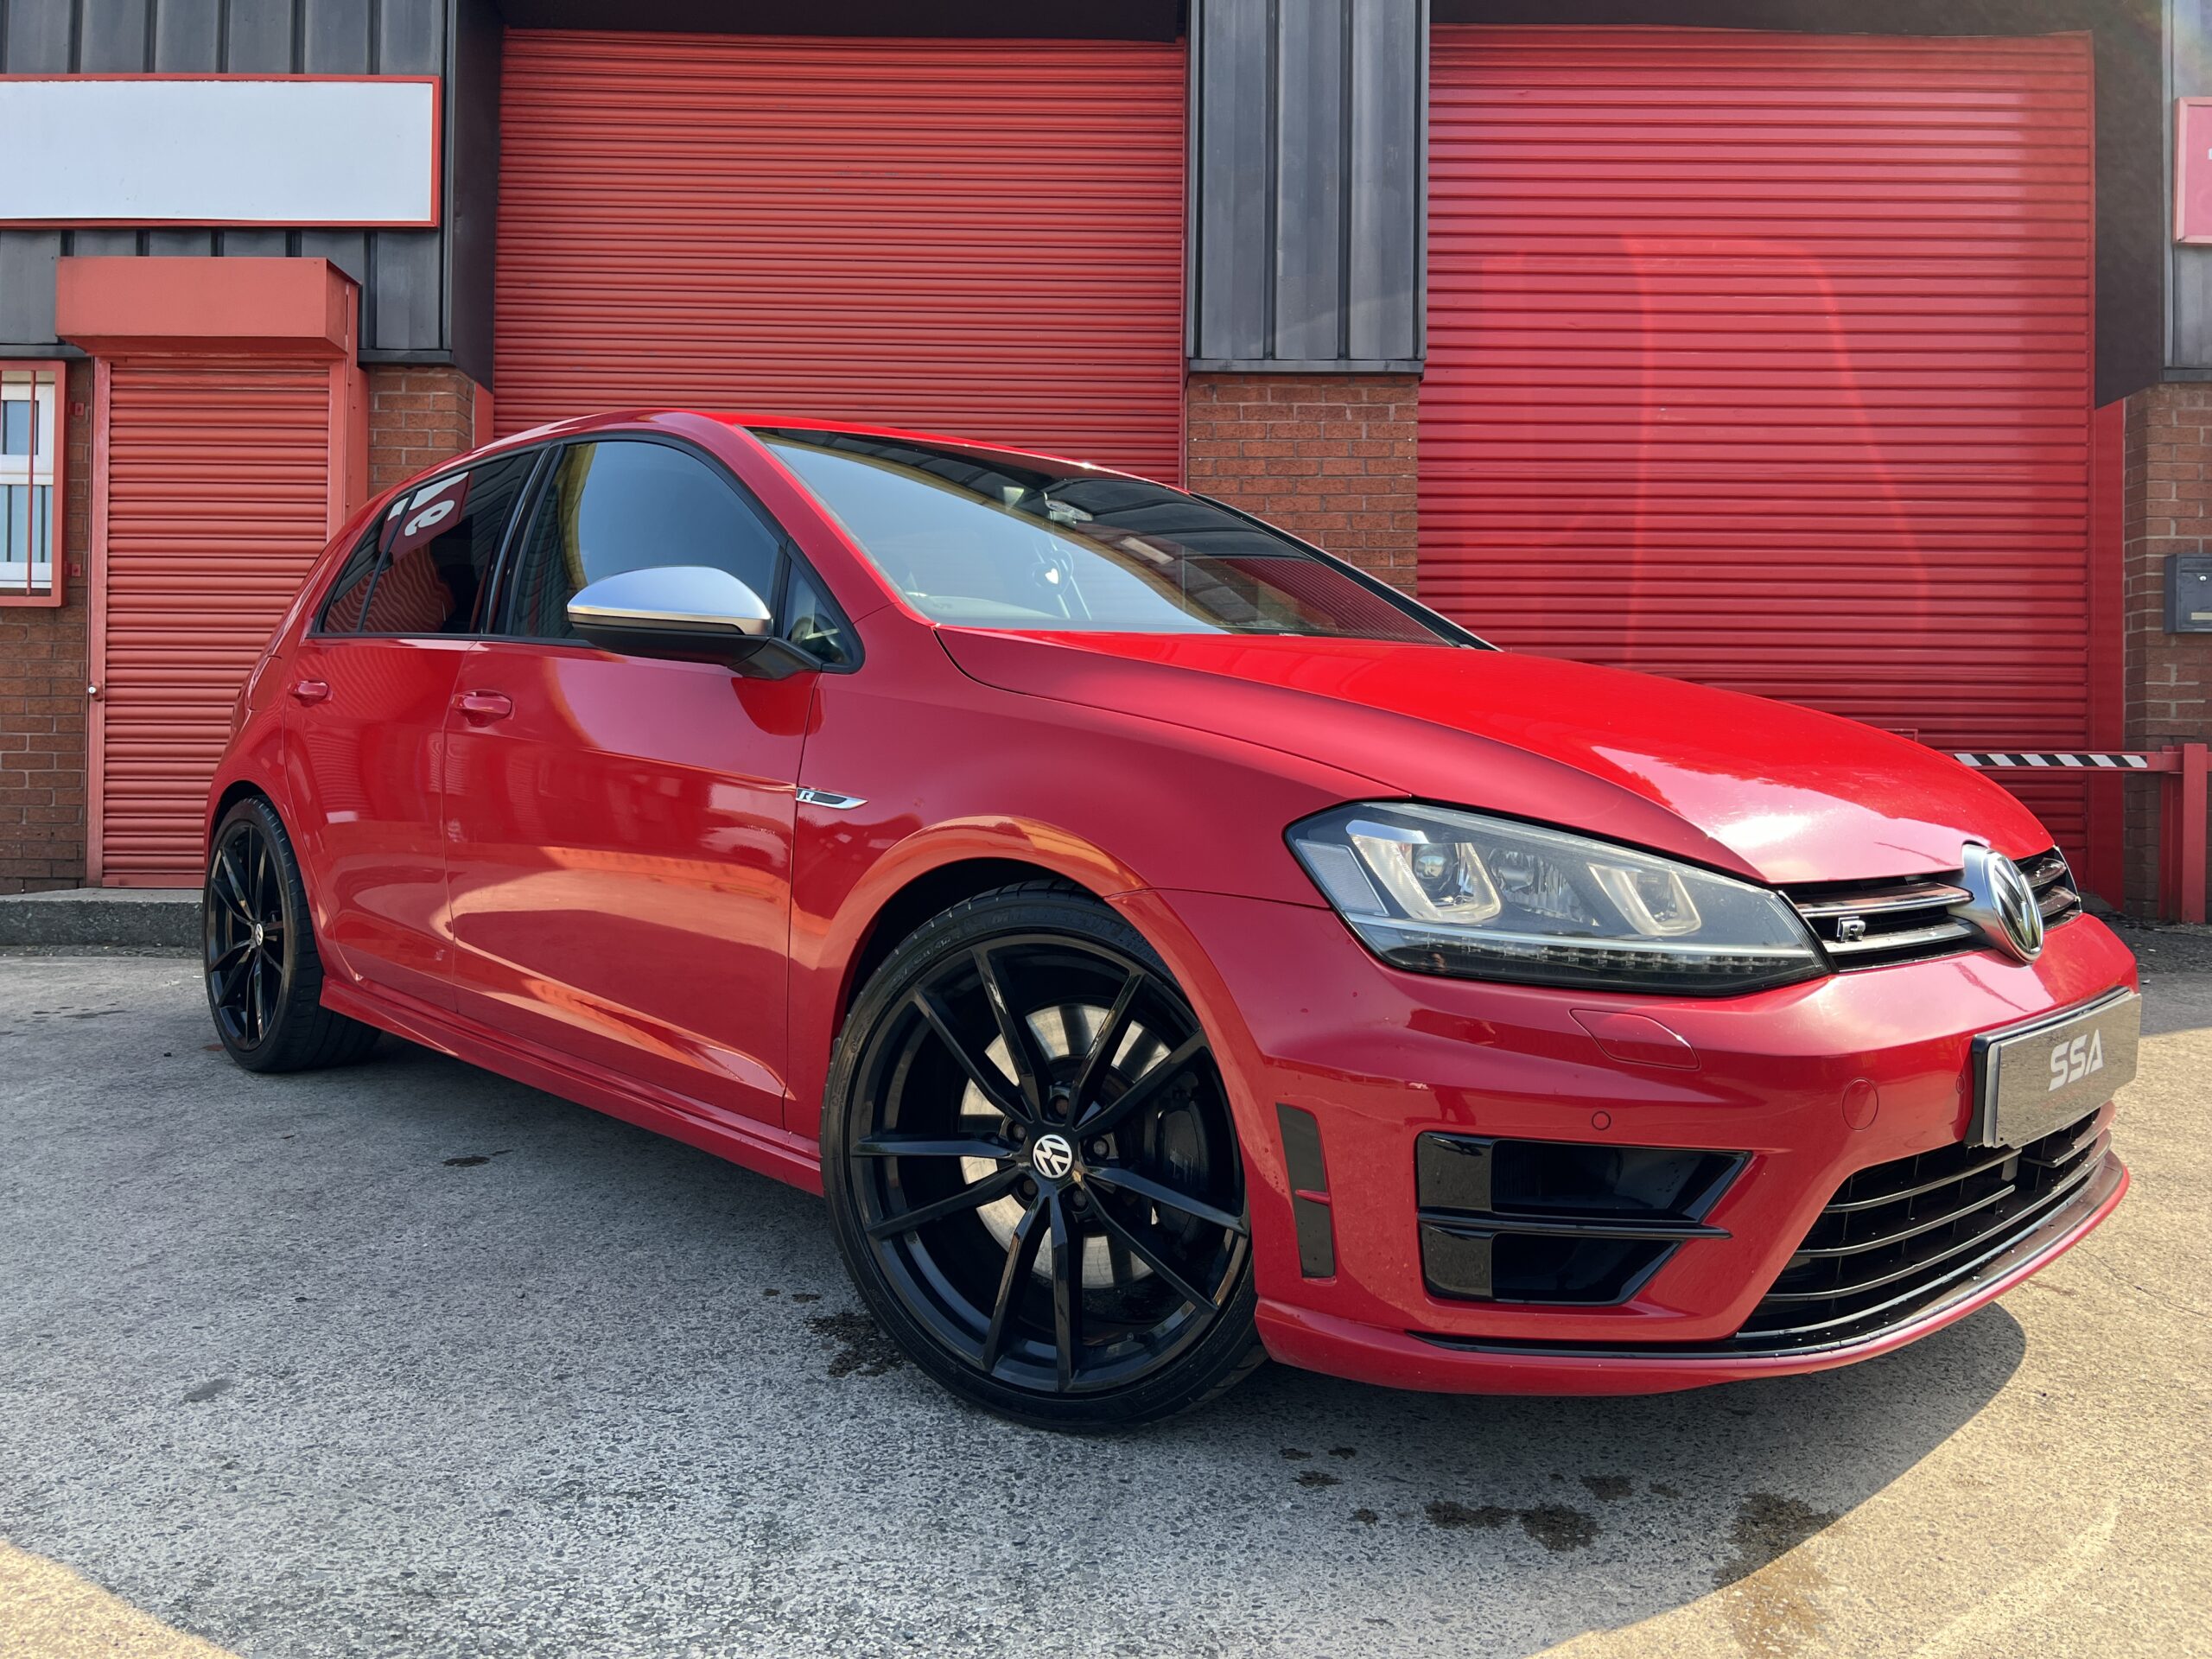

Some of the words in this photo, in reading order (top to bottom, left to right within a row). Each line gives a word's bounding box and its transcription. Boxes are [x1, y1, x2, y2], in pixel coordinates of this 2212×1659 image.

[798, 790, 815, 802] R
[1837, 916, 1866, 941] R
[2048, 1028, 2104, 1092] SSA
